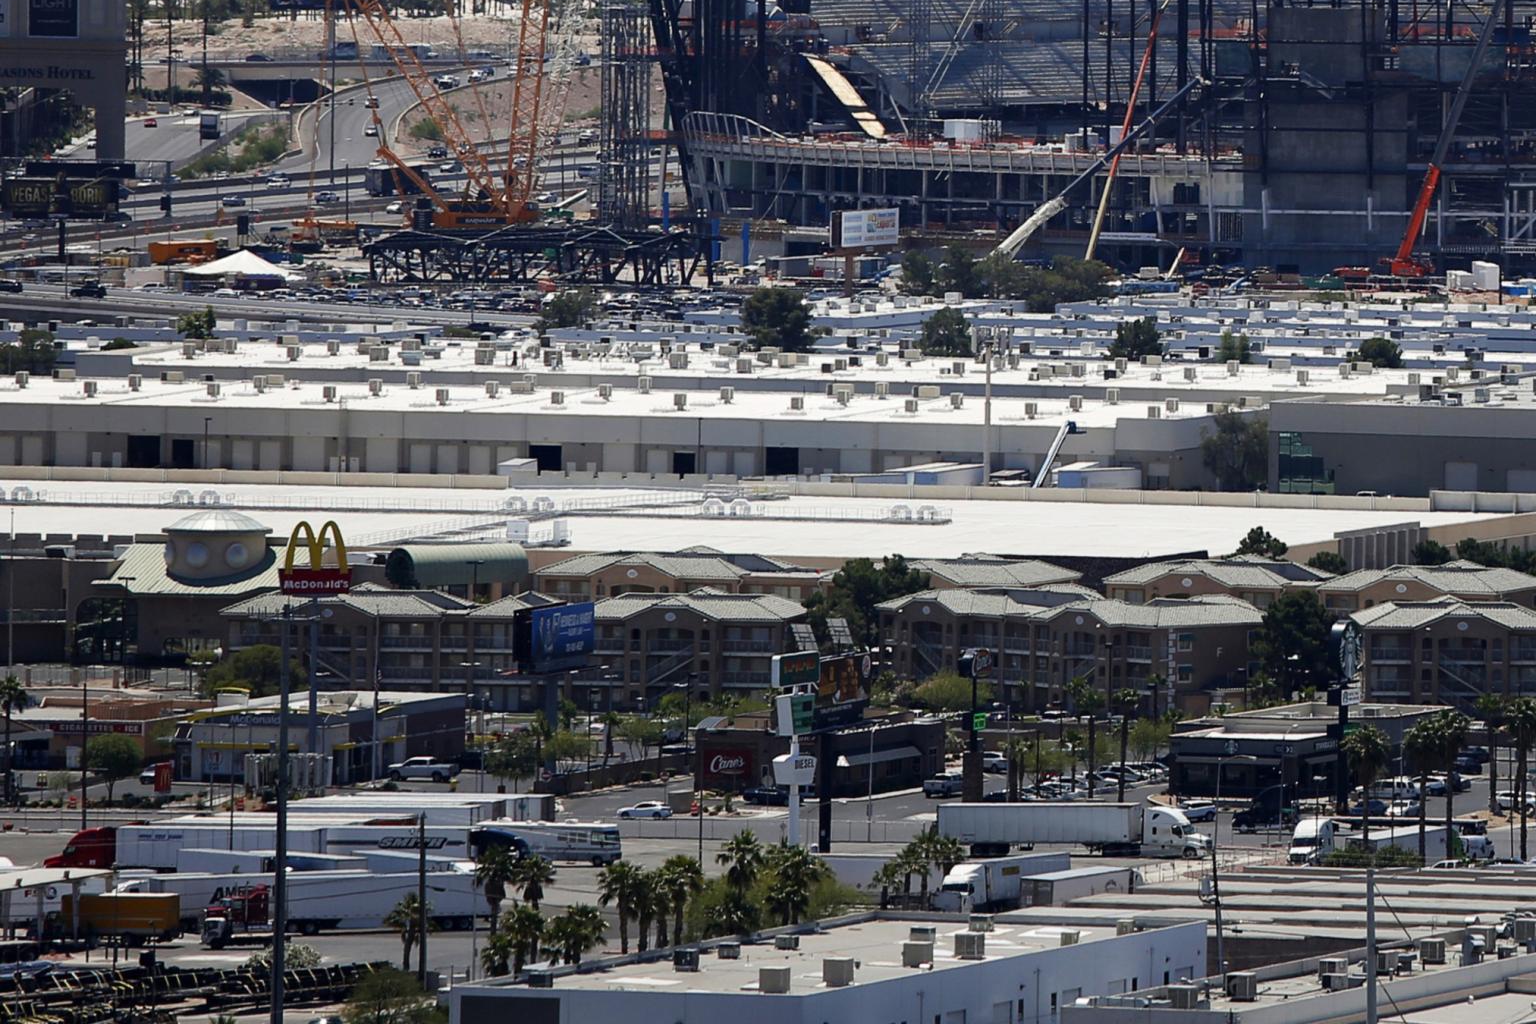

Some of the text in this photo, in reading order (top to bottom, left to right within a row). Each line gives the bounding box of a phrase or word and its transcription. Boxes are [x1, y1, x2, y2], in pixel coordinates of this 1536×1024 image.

[10, 185, 106, 203] VEGAS BORN
[283, 580, 349, 589] McDonald's
